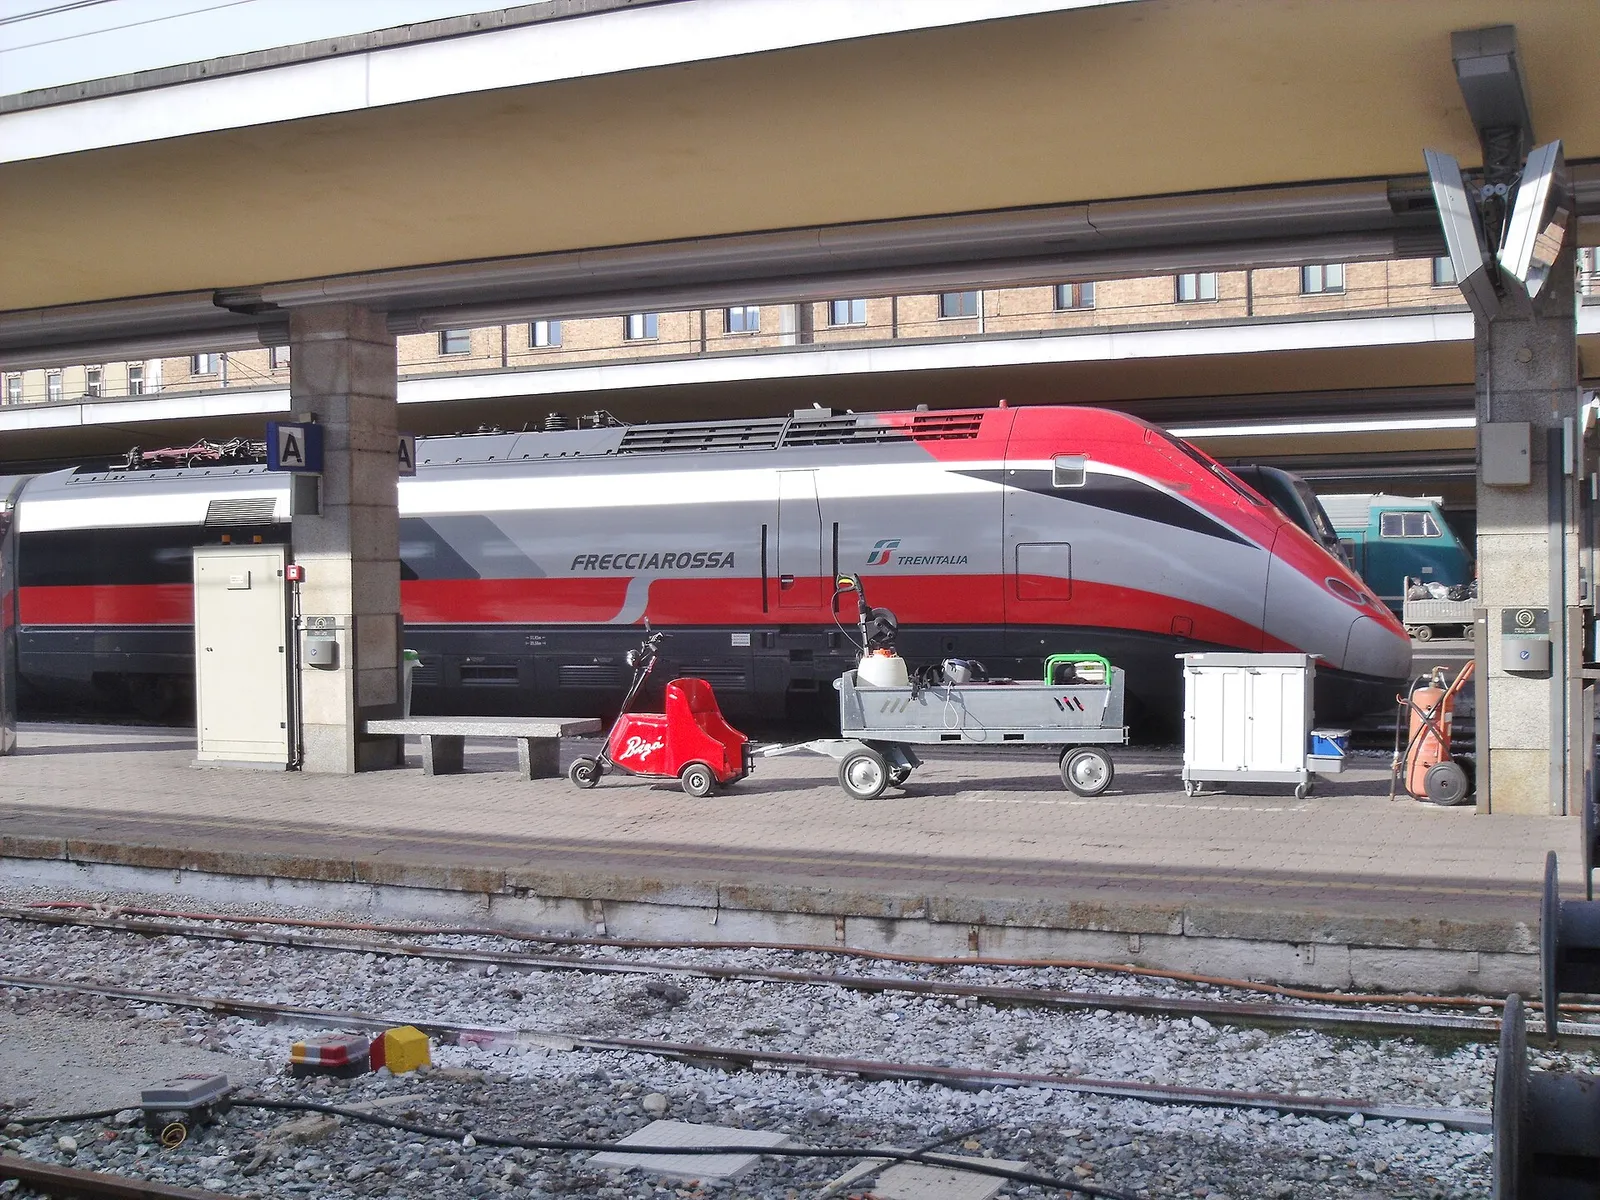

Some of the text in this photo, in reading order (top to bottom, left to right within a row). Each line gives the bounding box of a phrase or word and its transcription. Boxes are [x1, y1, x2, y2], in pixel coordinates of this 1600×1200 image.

[281, 433, 303, 463] A
[399, 438, 412, 468] A
[570, 551, 735, 571] FRECCIAROSSA
[898, 555, 968, 565] TRENITALIA
